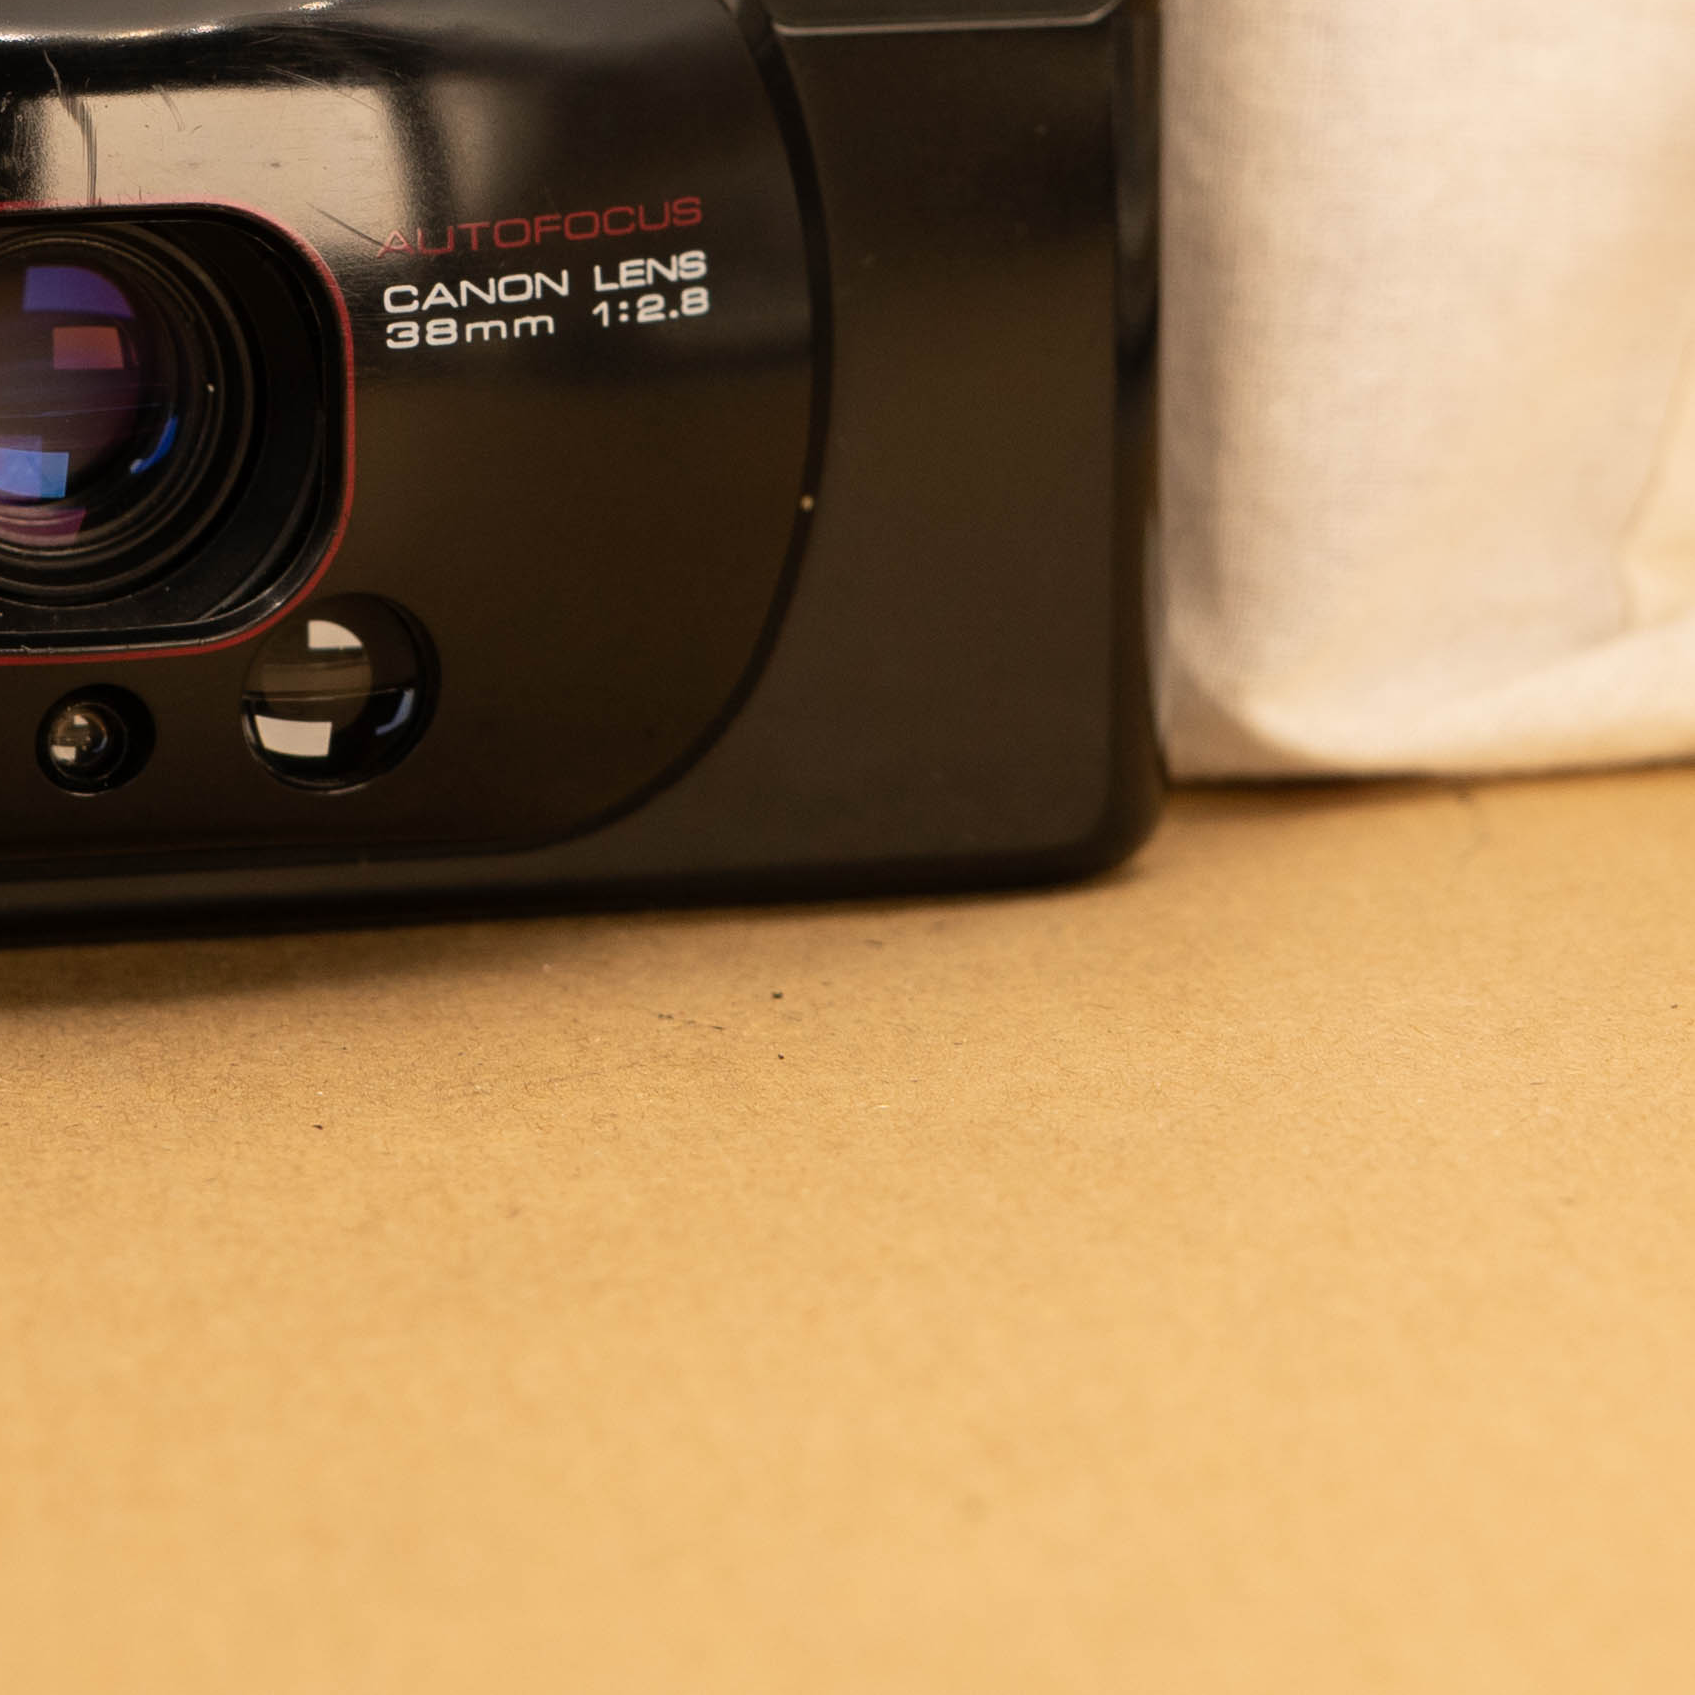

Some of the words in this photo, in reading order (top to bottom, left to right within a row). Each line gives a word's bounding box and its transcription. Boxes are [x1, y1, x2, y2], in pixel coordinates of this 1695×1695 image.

[378, 196, 703, 258] AUTOFOCUS
[383, 269, 570, 313] CANON
[593, 249, 708, 292] LENS
[385, 313, 556, 350] 38mm
[591, 286, 710, 328] 1:2.8
